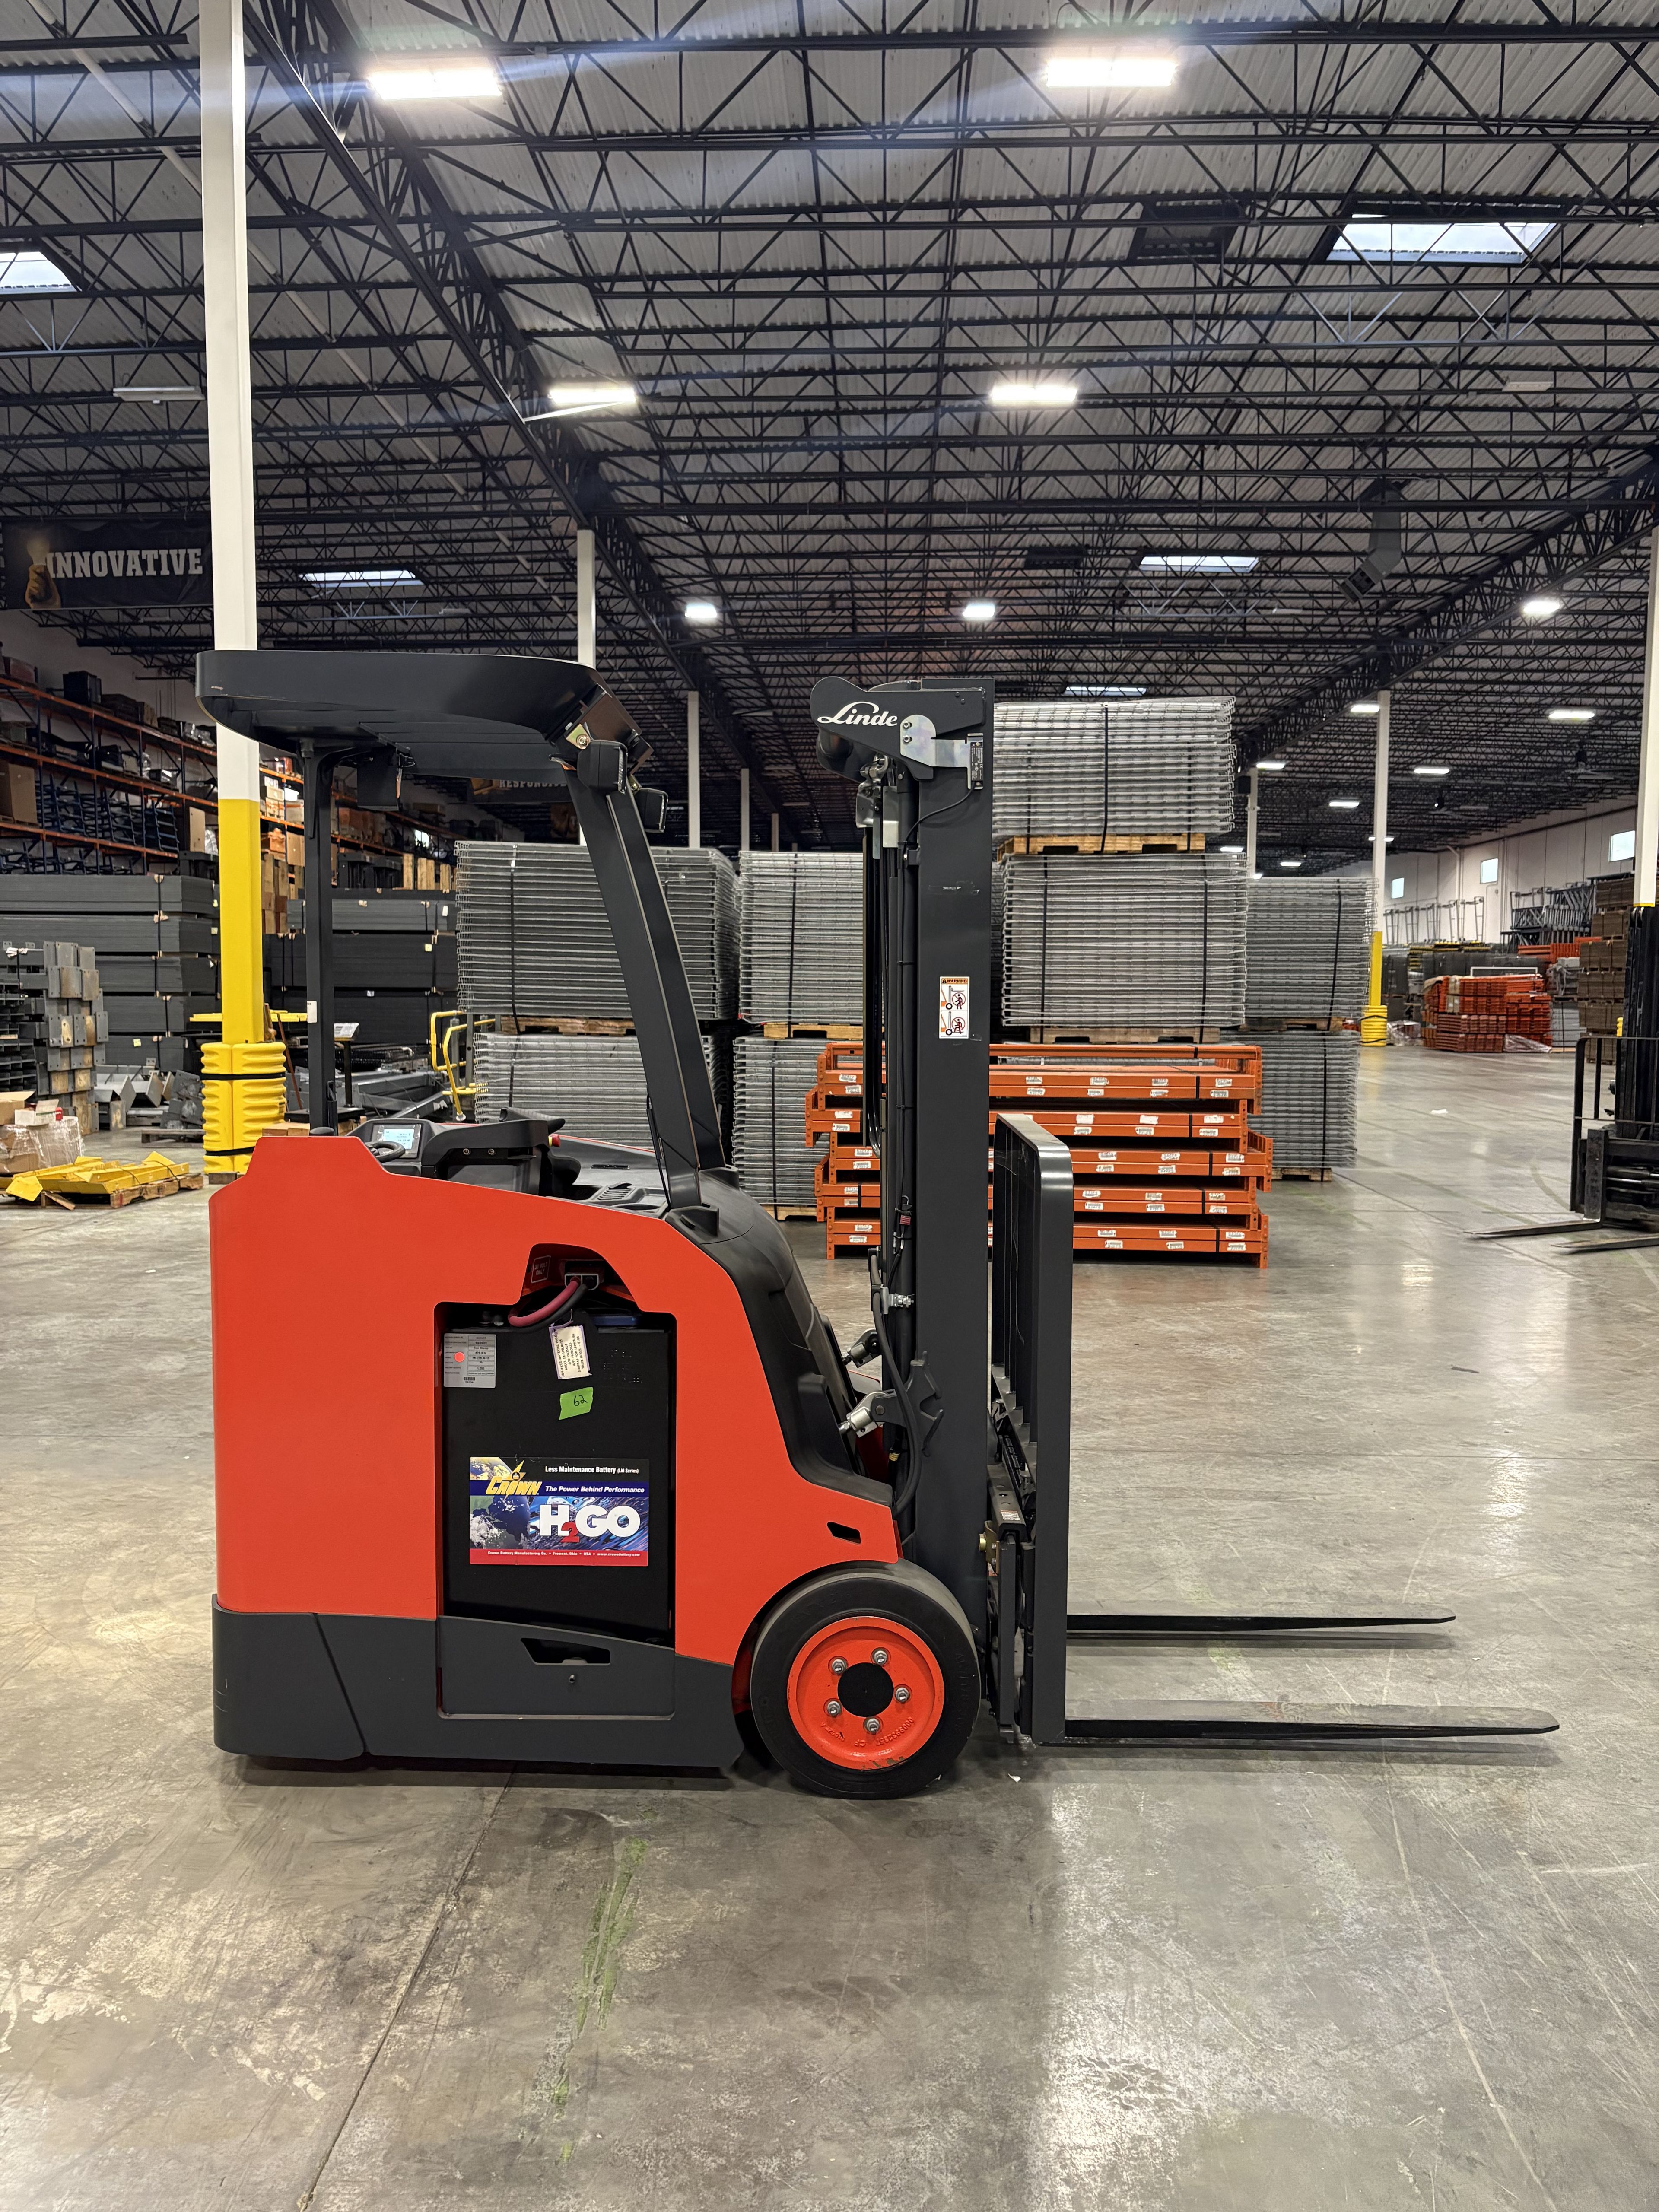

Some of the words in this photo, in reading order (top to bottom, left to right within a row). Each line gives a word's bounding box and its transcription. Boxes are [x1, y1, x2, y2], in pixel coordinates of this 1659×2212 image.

[46, 548, 203, 578] INNOVATIVE
[817, 701, 898, 727] Linde
[574, 1395, 588, 1406] 62
[486, 1475, 542, 1495] CROWN
[539, 1504, 641, 1543] H2GO
